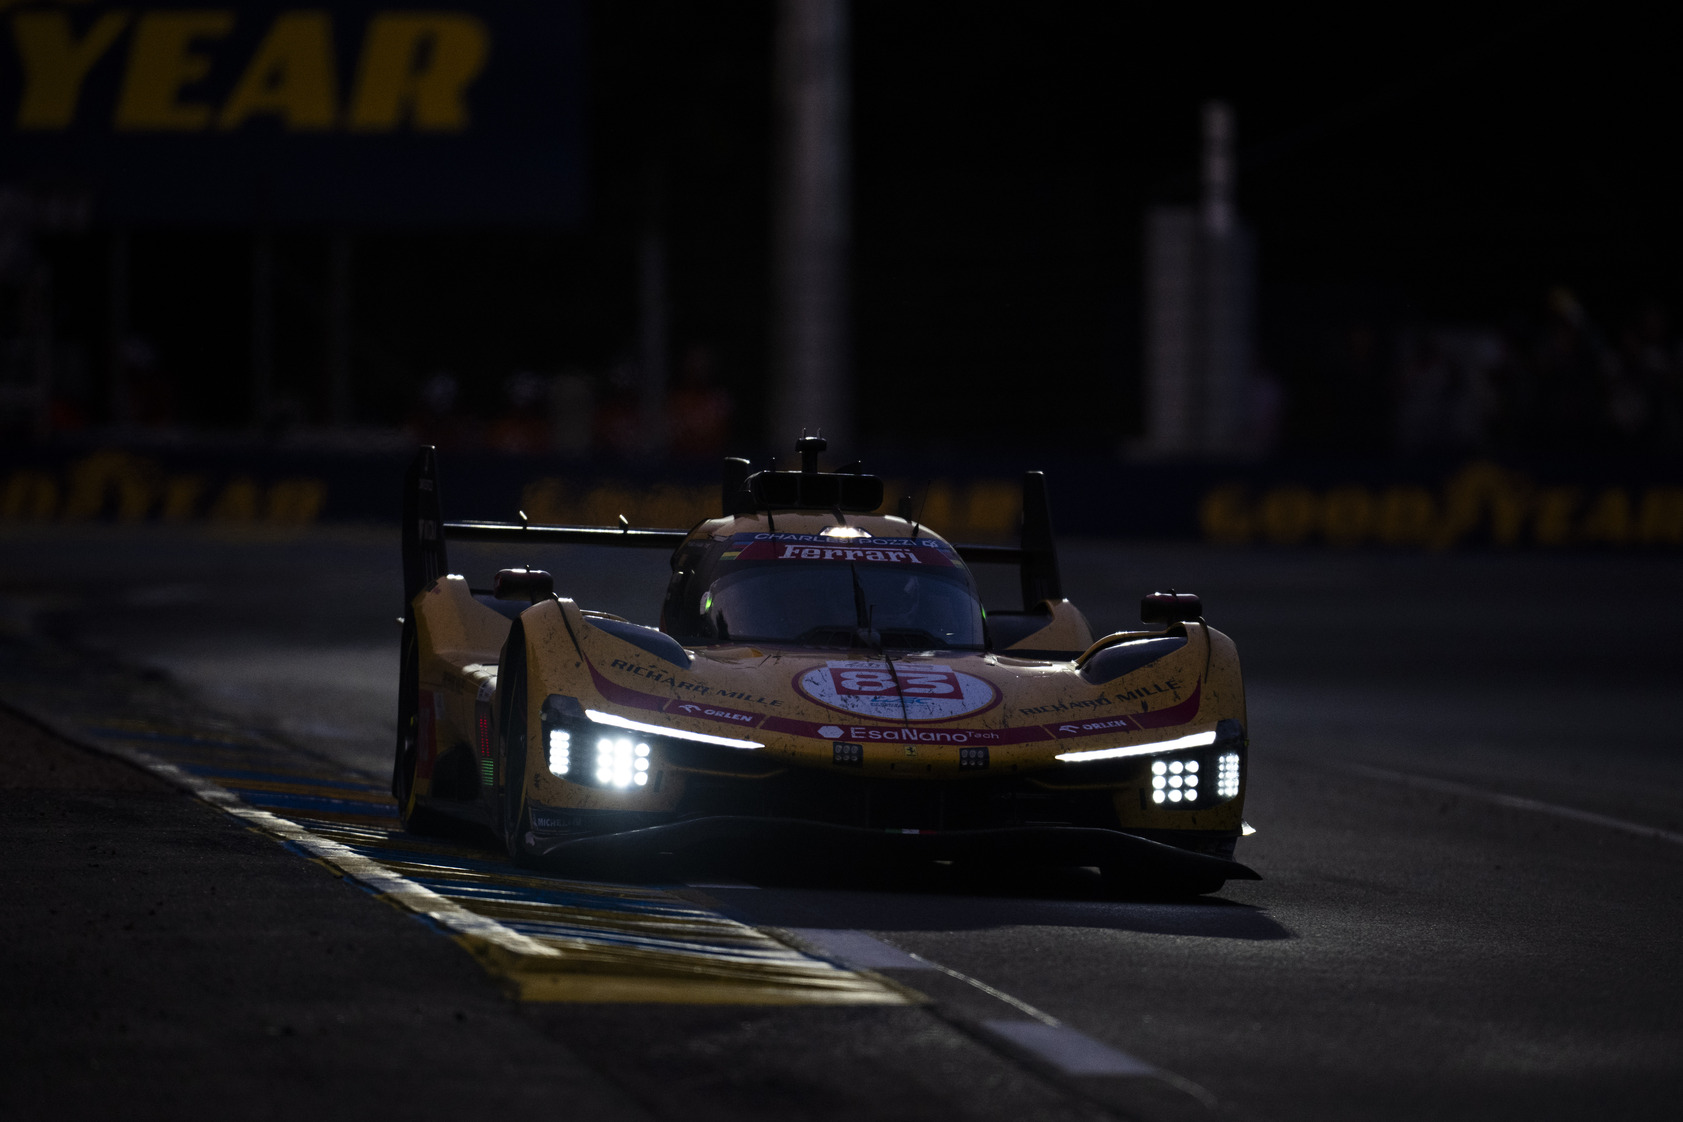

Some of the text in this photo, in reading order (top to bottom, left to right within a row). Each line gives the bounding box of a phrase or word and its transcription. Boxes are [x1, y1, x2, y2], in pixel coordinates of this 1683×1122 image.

[8, 8, 491, 133] YEAR
[777, 544, 922, 564] Ferrari
[611, 658, 785, 708] RICHARD MILLE
[839, 671, 954, 694] 83
[1020, 679, 1183, 716] RICHARD MILLE
[703, 709, 753, 723] ORLEN
[1082, 719, 1127, 731] ORLEN
